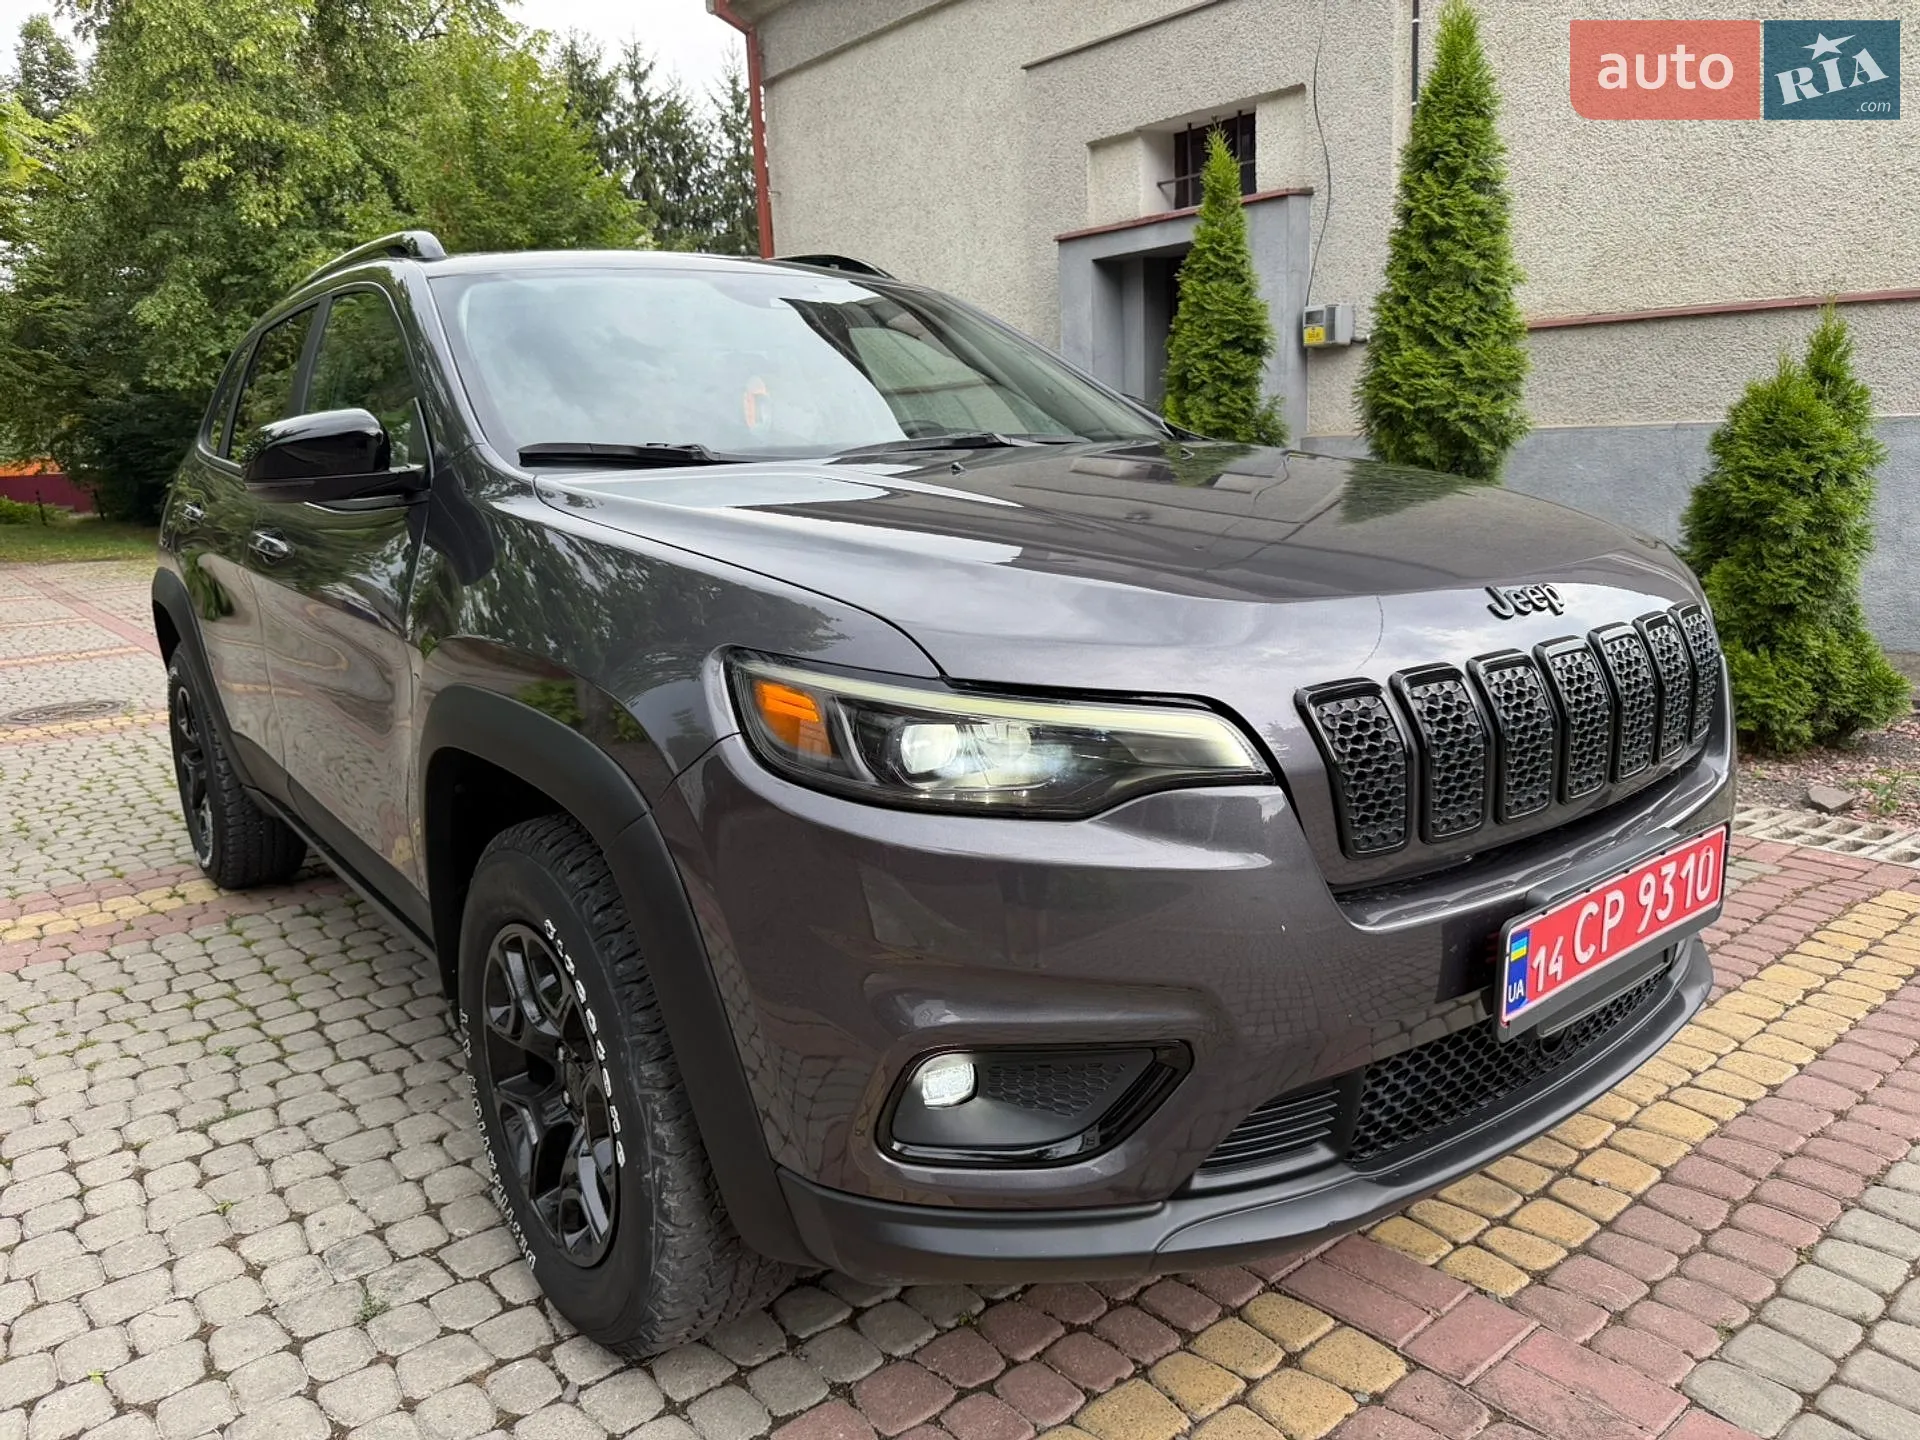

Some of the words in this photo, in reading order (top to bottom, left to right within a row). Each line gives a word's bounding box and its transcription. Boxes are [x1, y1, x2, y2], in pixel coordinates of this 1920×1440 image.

[1484, 583, 1564, 620] Jeep
[1532, 936, 1565, 993] 14
[1573, 889, 1625, 964] CP
[1636, 845, 1715, 934] 9310
[1508, 981, 1525, 1003] UA
